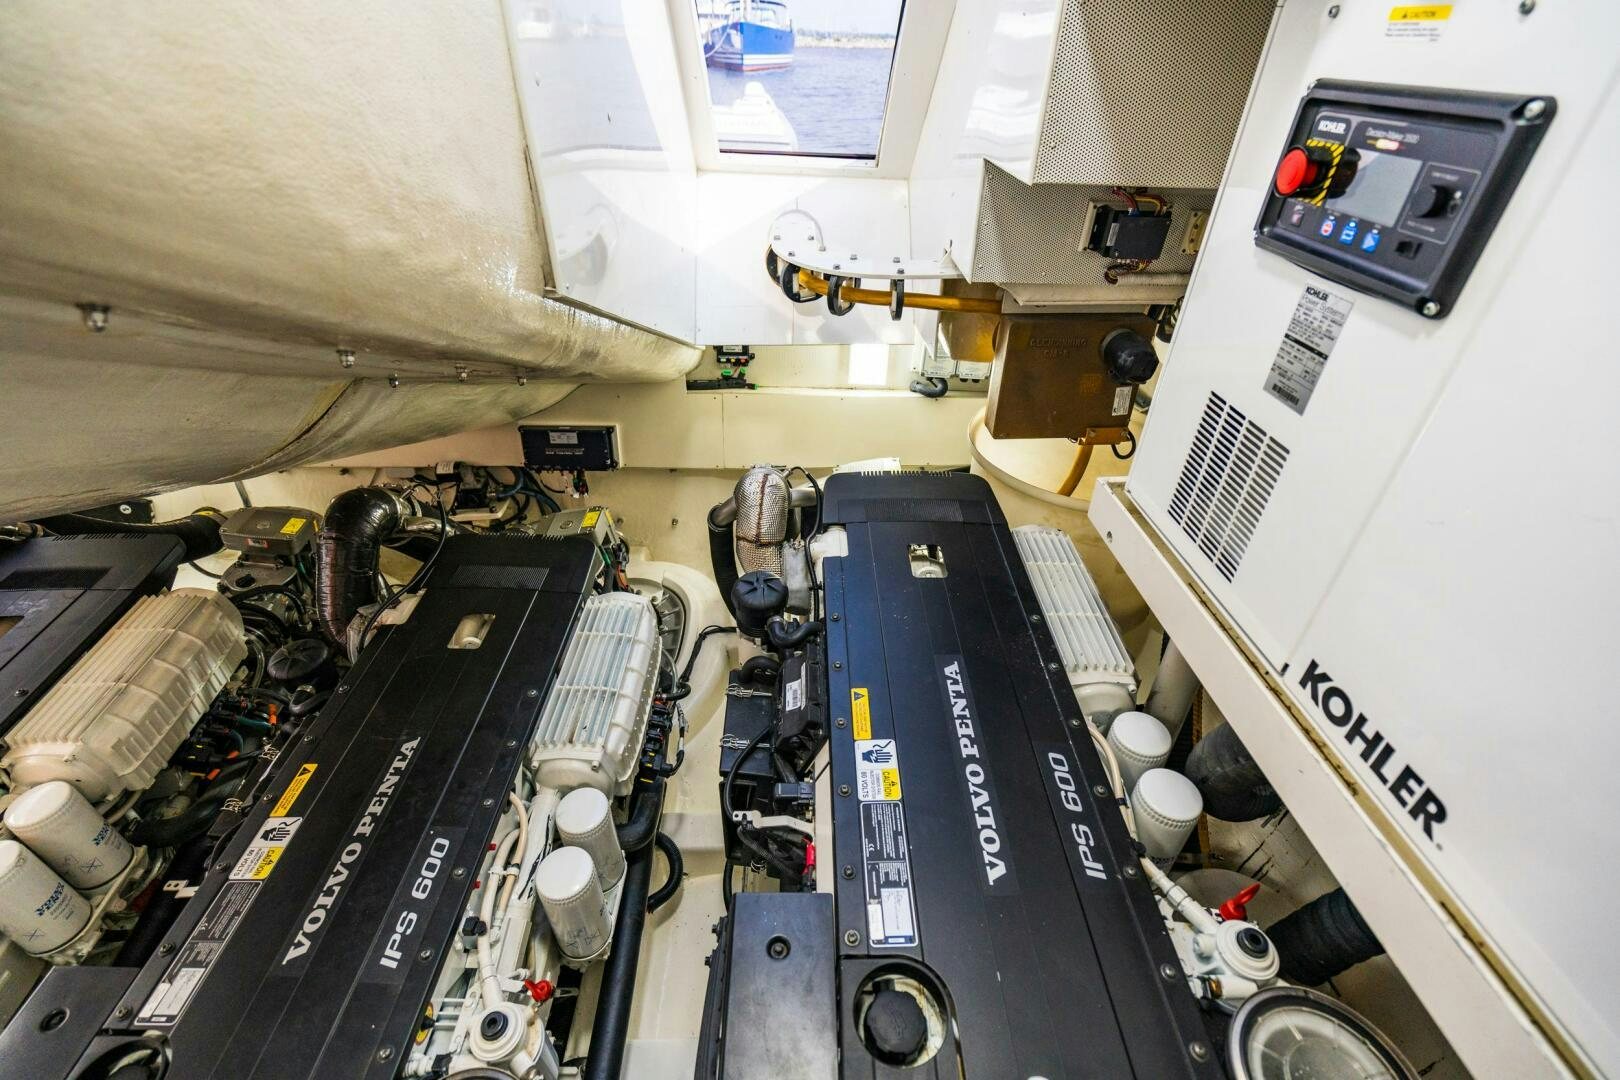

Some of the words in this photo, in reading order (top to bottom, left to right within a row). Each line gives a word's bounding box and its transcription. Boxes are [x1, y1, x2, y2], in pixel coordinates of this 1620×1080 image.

[1317, 120, 1346, 135] KOHLER
[1305, 286, 1329, 301] KOHLER
[943, 660, 980, 759] PENTA
[1299, 658, 1448, 842] KOHLER
[861, 780, 869, 799] VOLTS
[882, 771, 892, 797] CAUTION
[1048, 752, 1083, 813] 600
[282, 842, 362, 965] VOLVO
[353, 736, 421, 837] PENTA
[964, 762, 1008, 886] VOLVO
[1071, 822, 1108, 880] IPS
[254, 849, 275, 876] CAUTION
[379, 910, 418, 969] IPS
[411, 837, 450, 900] 600
